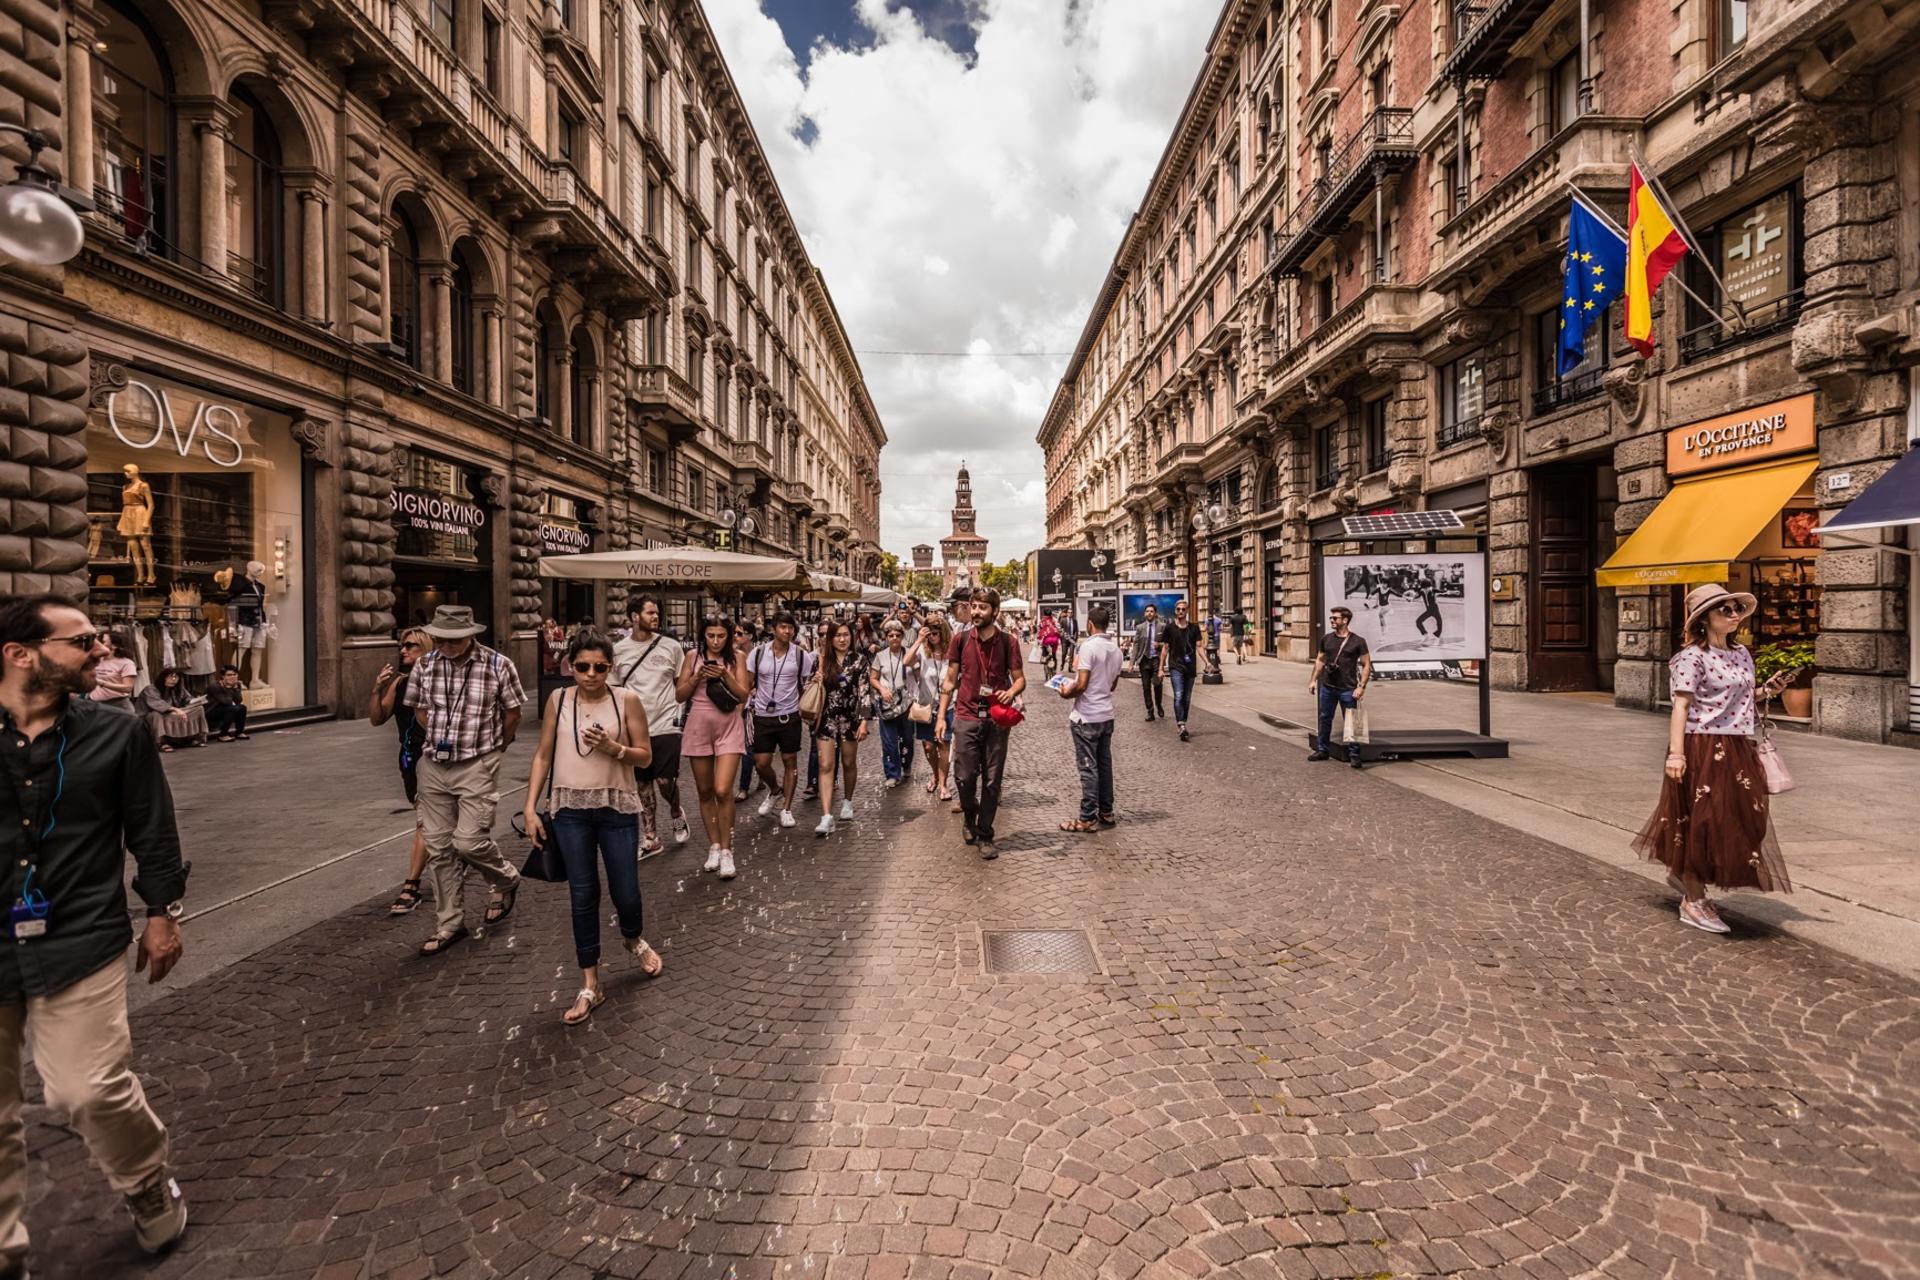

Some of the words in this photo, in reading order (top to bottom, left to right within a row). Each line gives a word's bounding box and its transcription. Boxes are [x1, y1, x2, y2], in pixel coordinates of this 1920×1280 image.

[1727, 266, 1781, 293] Cervantes
[108, 379, 242, 467] OVS
[1684, 413, 1785, 451] L'OCCITANE
[1698, 446, 1712, 458] EN
[1715, 433, 1772, 454] PROVENCE
[390, 490, 485, 526] SIGNORVINO
[411, 516, 429, 529] 100%
[430, 520, 444, 532] VINI
[538, 524, 590, 548] IGNORVINO
[626, 562, 663, 576] WINE
[667, 563, 713, 577] STORE
